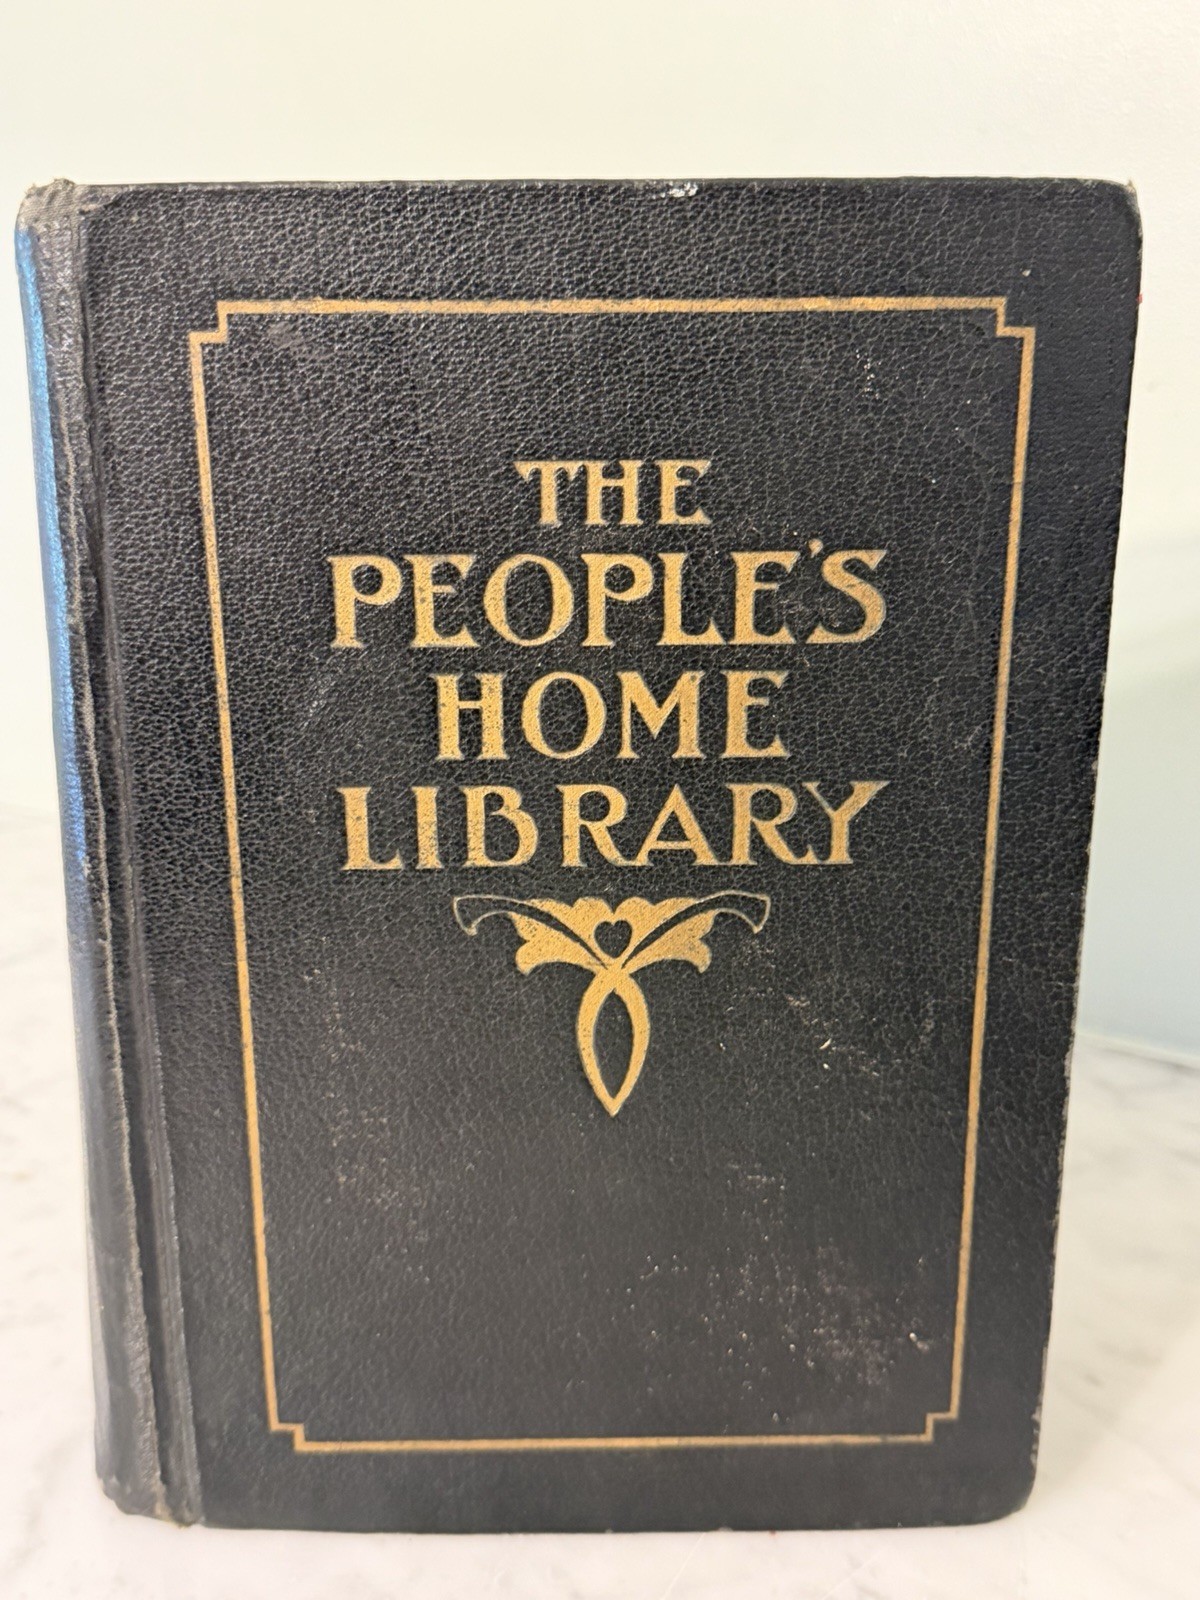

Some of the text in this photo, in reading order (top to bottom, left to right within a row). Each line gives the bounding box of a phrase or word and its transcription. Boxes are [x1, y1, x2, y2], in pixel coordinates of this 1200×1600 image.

[514, 459, 711, 526] THE
[326, 540, 887, 649] PEOPLE'S
[433, 670, 789, 761] HOME
[337, 780, 890, 871] LIBRARY
